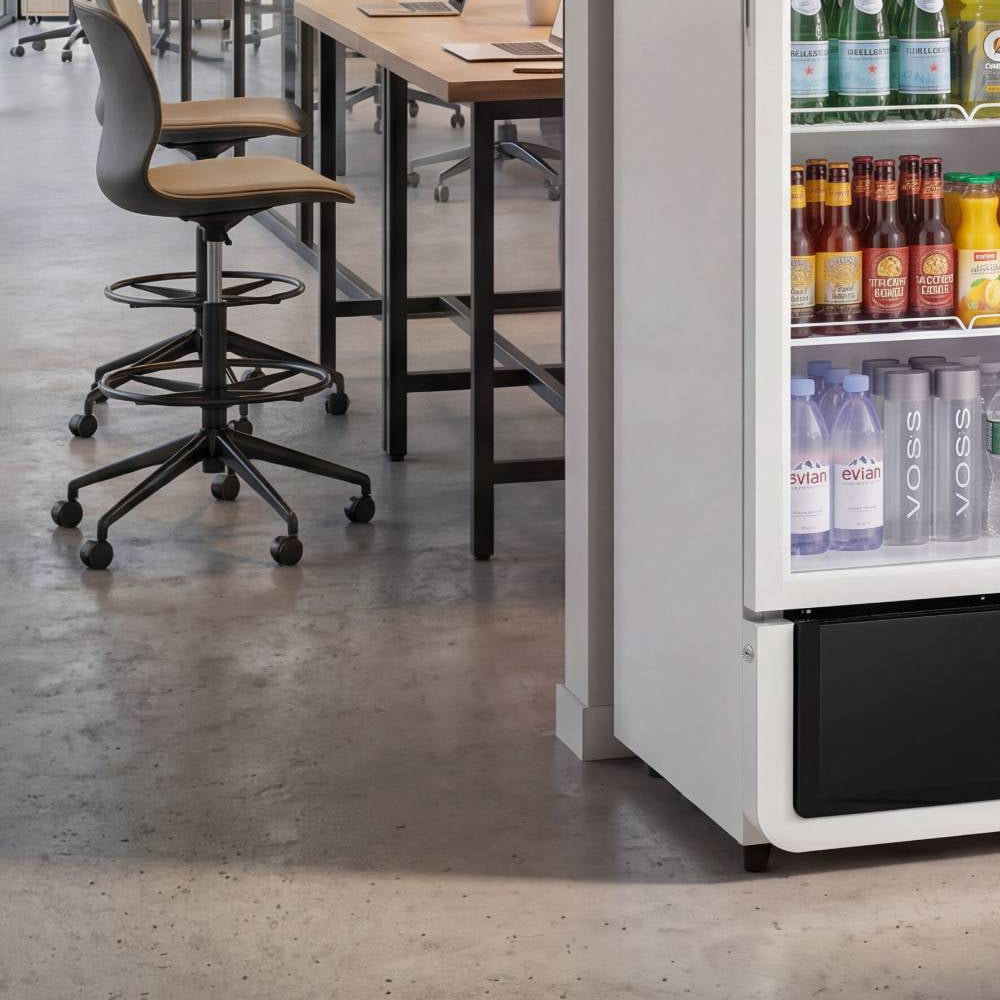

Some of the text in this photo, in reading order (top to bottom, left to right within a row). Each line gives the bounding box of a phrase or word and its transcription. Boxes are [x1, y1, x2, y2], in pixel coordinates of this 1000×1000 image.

[842, 466, 881, 481] evian
[906, 410, 921, 518] VOSS
[955, 408, 971, 516] VOSS
